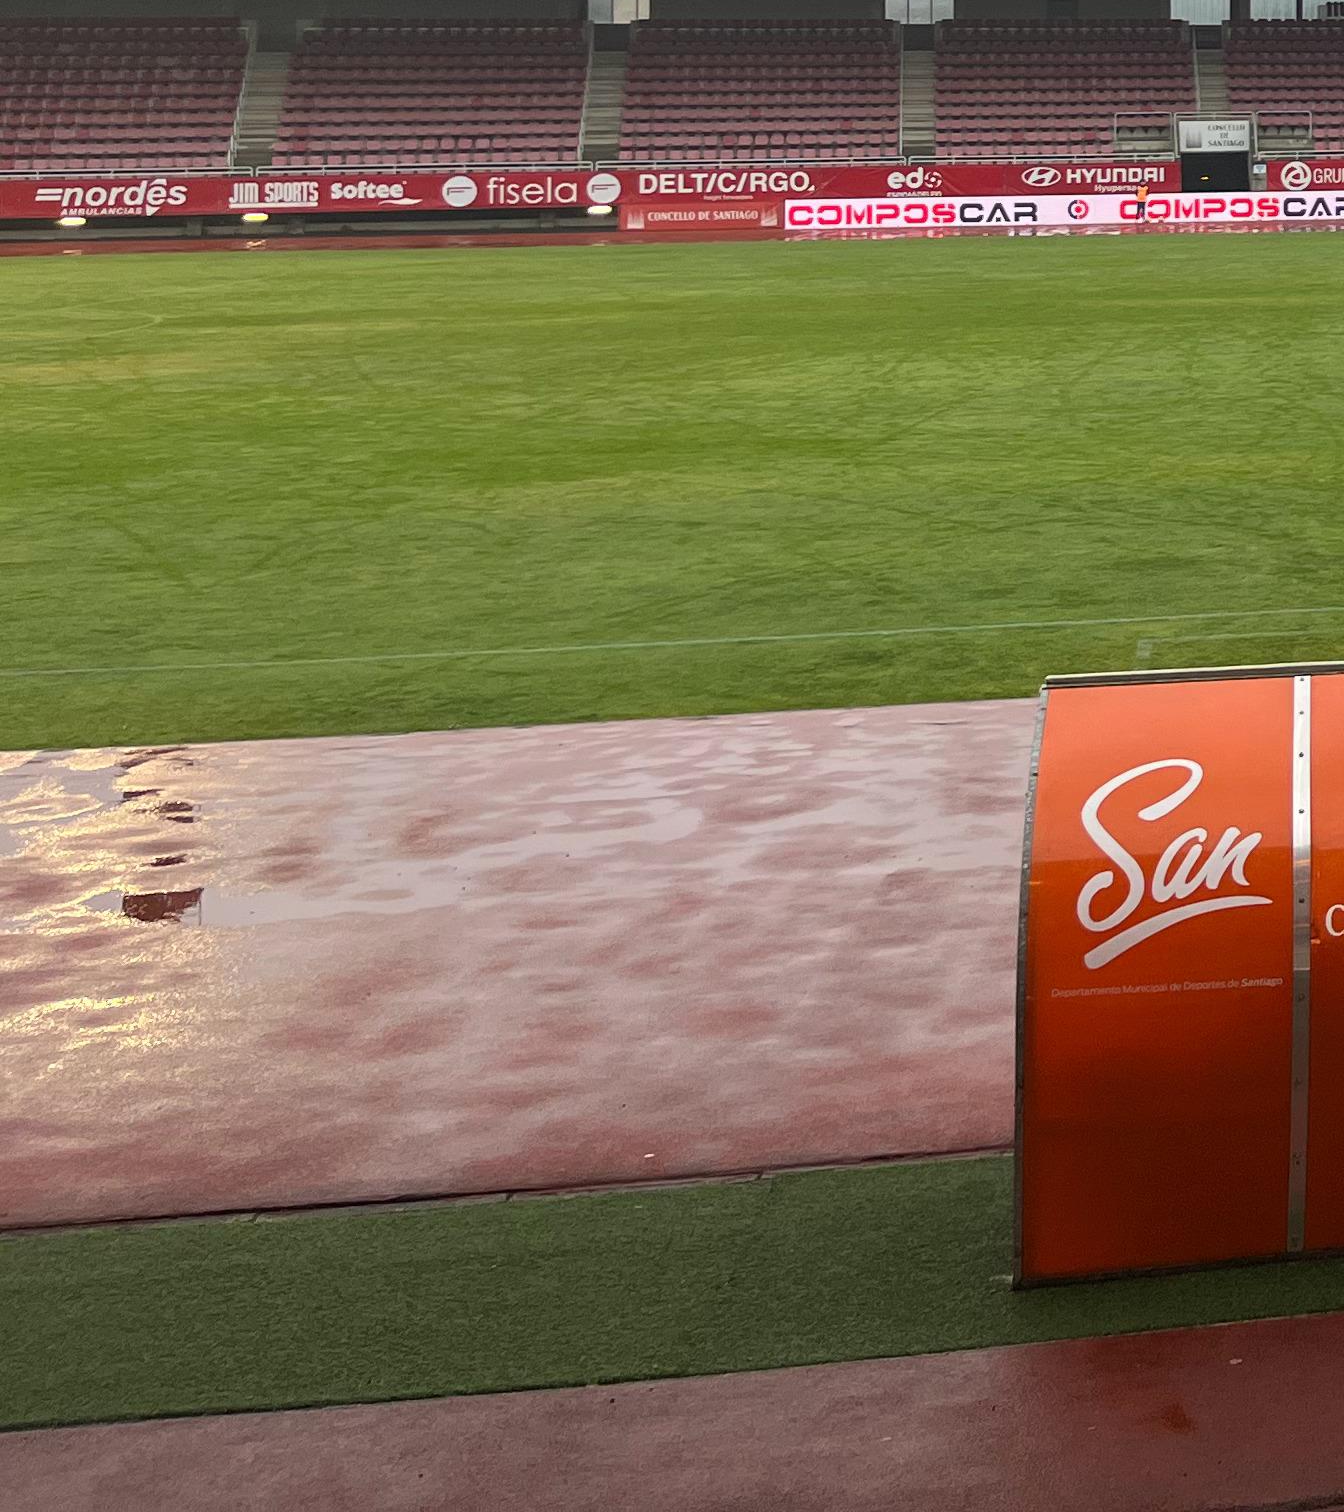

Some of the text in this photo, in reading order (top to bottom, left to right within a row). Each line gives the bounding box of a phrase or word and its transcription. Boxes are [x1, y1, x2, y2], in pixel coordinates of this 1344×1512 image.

[1066, 167, 1165, 184] HYUNDAI
[229, 181, 319, 203] JIM SPORTS
[487, 176, 578, 204] fisela
[60, 207, 143, 217] AMBULANCIAS
[648, 209, 759, 222] CONCELLO DE SANTIAGO
[788, 202, 1038, 226] COMPOSCAR
[1076, 758, 1263, 932] San
